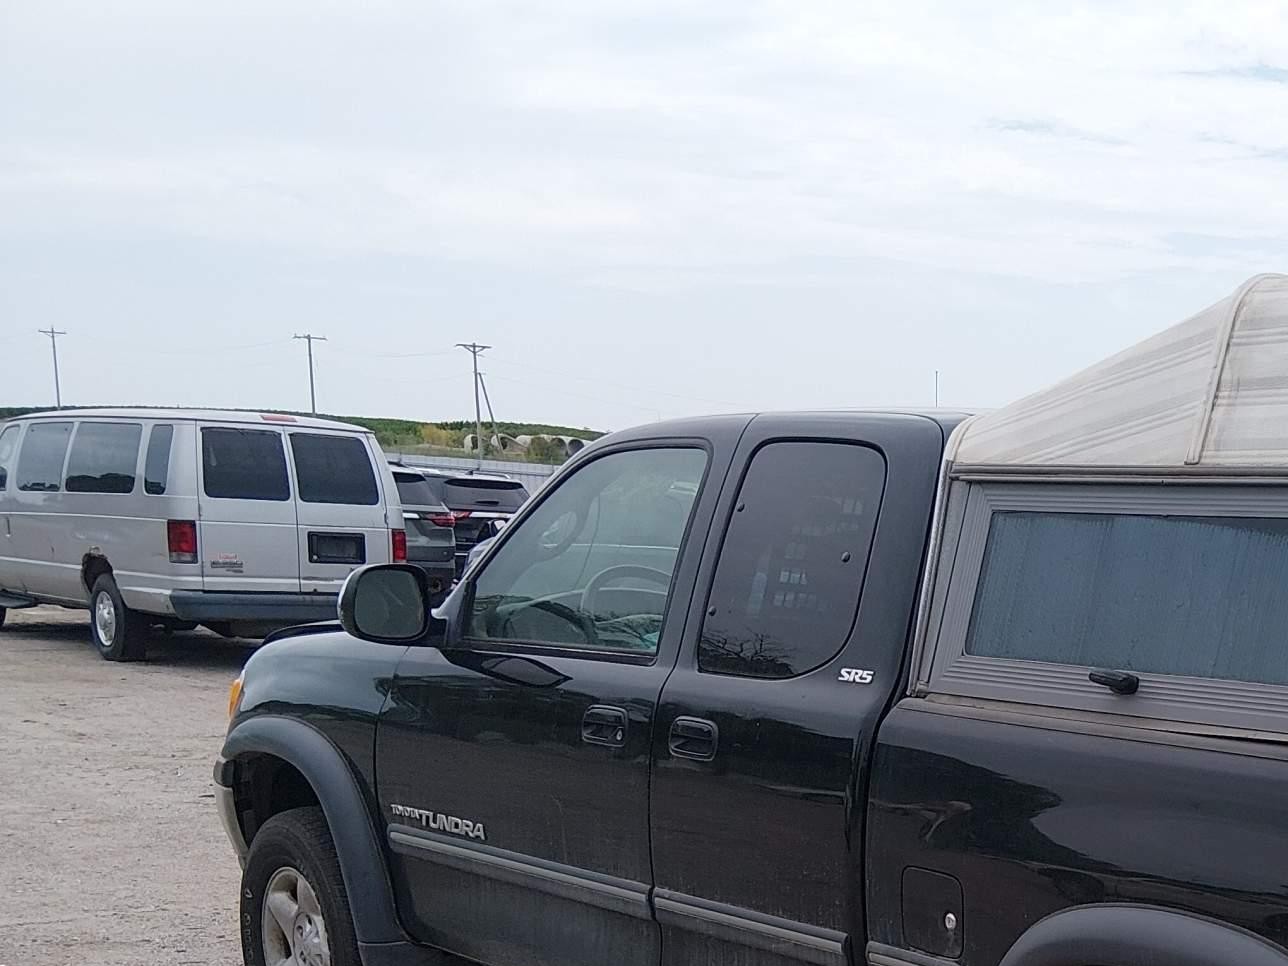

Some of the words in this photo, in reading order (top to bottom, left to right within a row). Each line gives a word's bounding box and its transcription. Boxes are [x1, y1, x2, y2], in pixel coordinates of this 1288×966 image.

[838, 668, 874, 683] SR5
[390, 804, 420, 819] TOYOTA
[419, 809, 486, 841] TUNDRA
